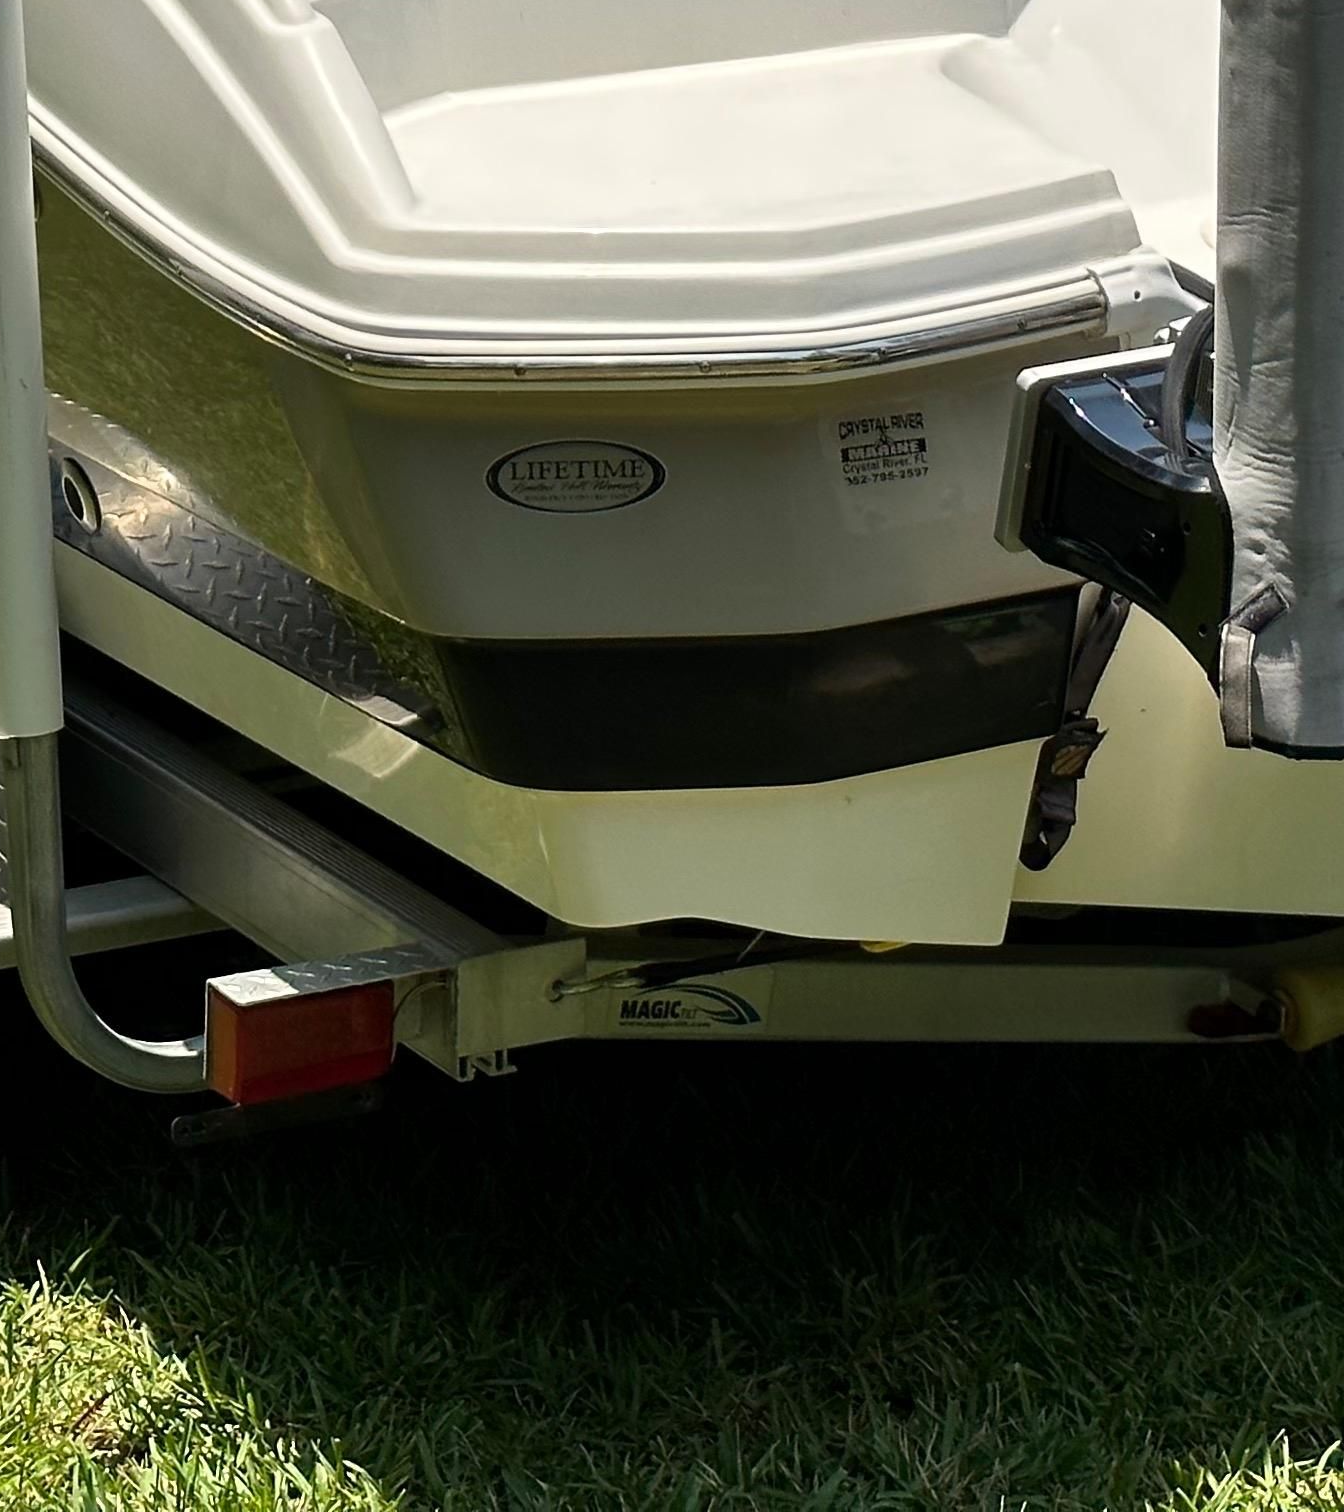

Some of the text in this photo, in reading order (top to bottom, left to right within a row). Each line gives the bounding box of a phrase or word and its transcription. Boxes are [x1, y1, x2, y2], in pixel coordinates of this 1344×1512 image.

[839, 412, 925, 440] CRYSTAL RIVER
[510, 460, 645, 480] LIFETIME
[842, 461, 881, 475] Crystal
[620, 999, 681, 1019] MAGIC
